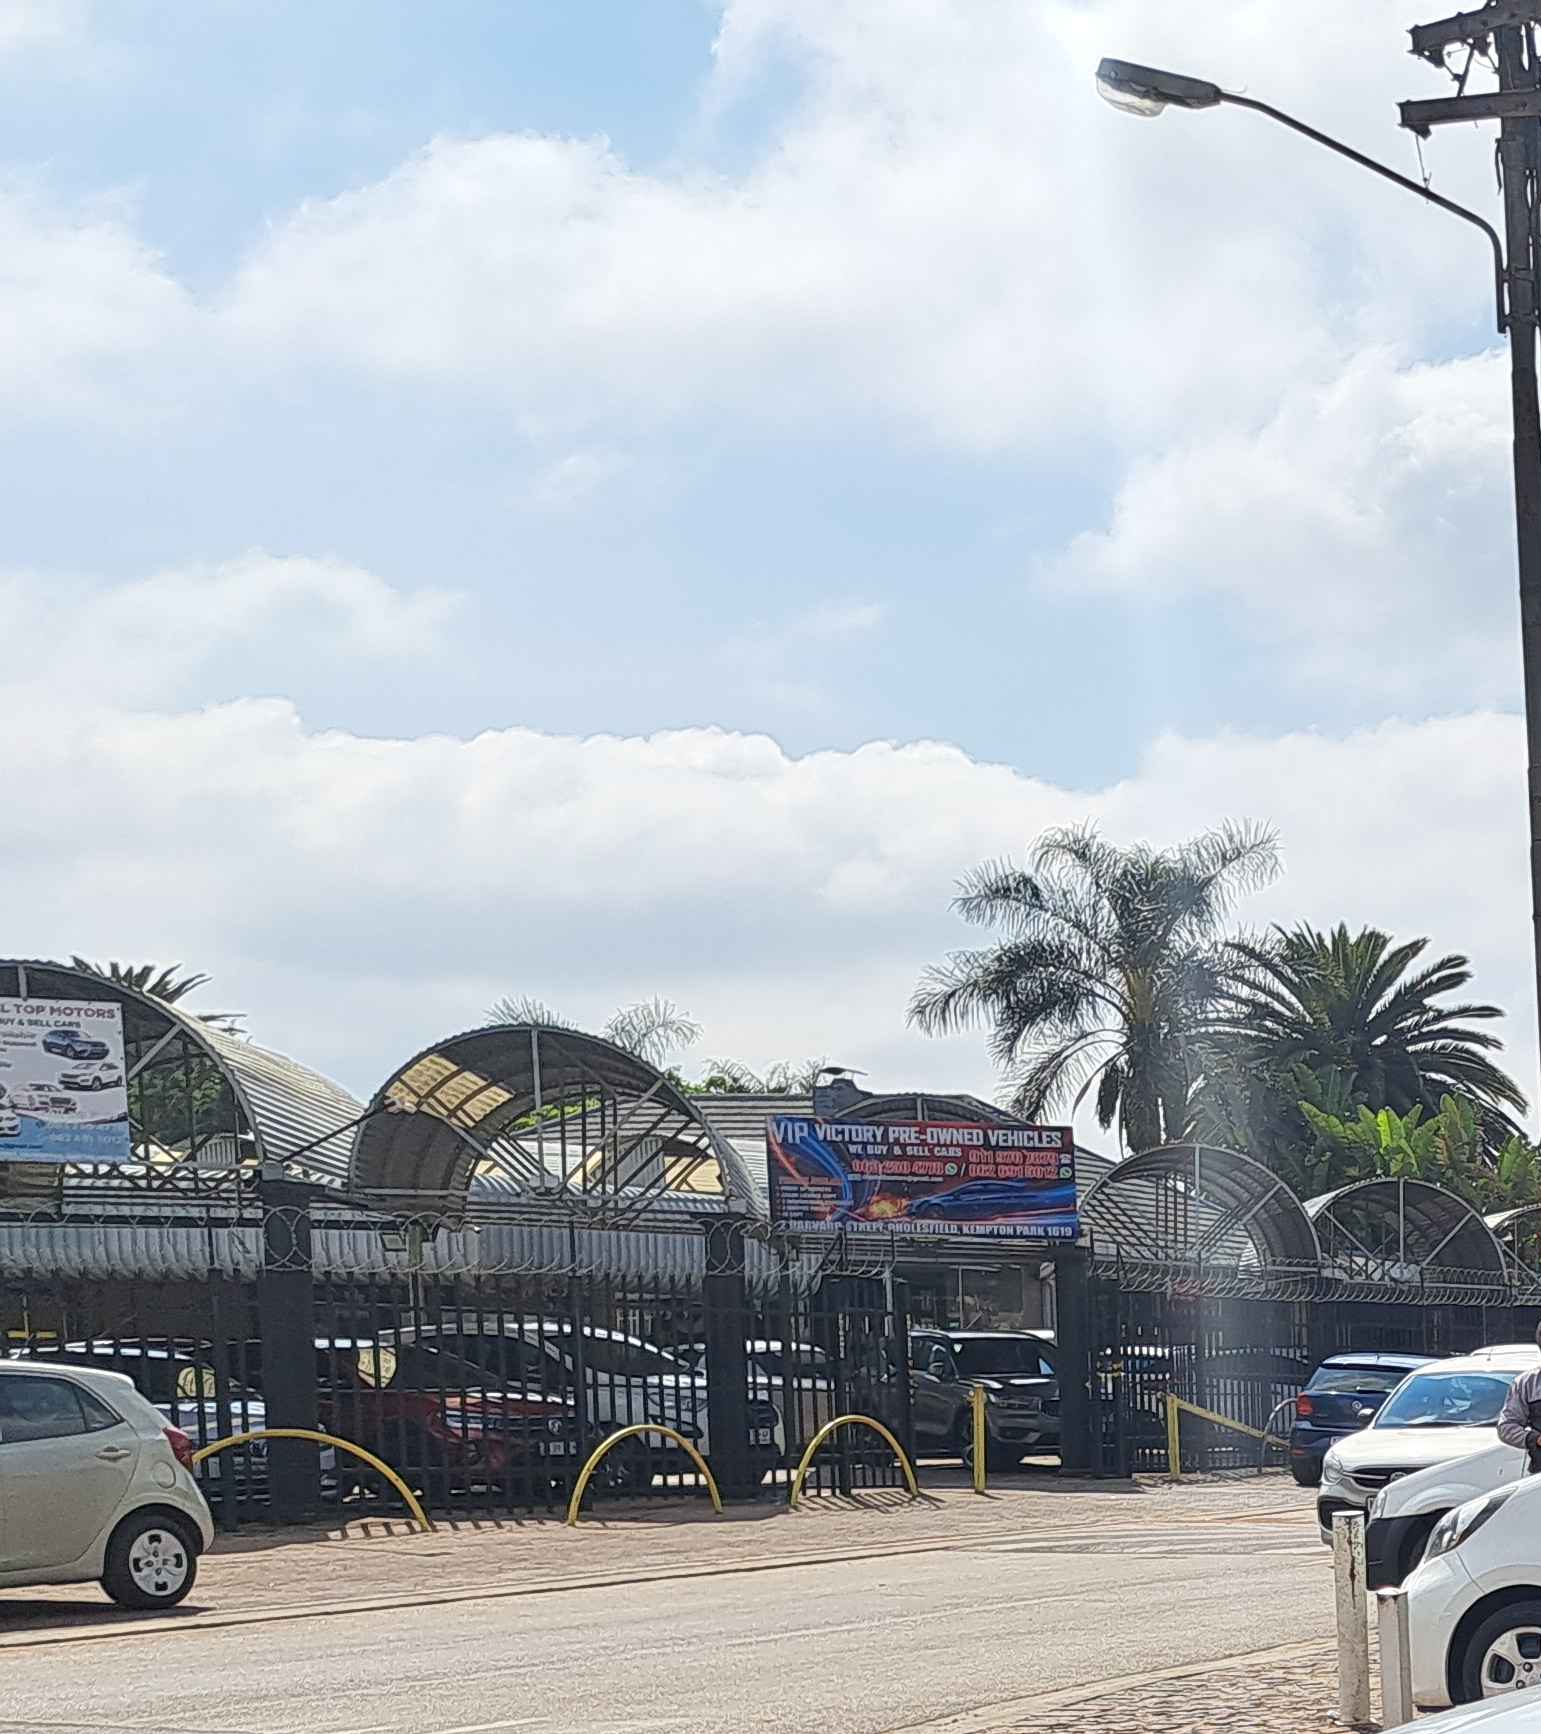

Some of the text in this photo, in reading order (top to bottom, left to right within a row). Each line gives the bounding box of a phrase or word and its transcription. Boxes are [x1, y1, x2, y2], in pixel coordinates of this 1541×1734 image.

[14, 1003, 46, 1015] TOP
[49, 1005, 116, 1019] MOTORS
[772, 1121, 1062, 1148] VIP VICTORY PRE-OWNED VEHICLES
[866, 1144, 888, 1155] BUY
[893, 1145, 902, 1156] &
[906, 1146, 931, 1157] SELL
[934, 1146, 962, 1157] CARS
[962, 1224, 1014, 1235] KEMPTON
[1016, 1225, 1045, 1236] PARK
